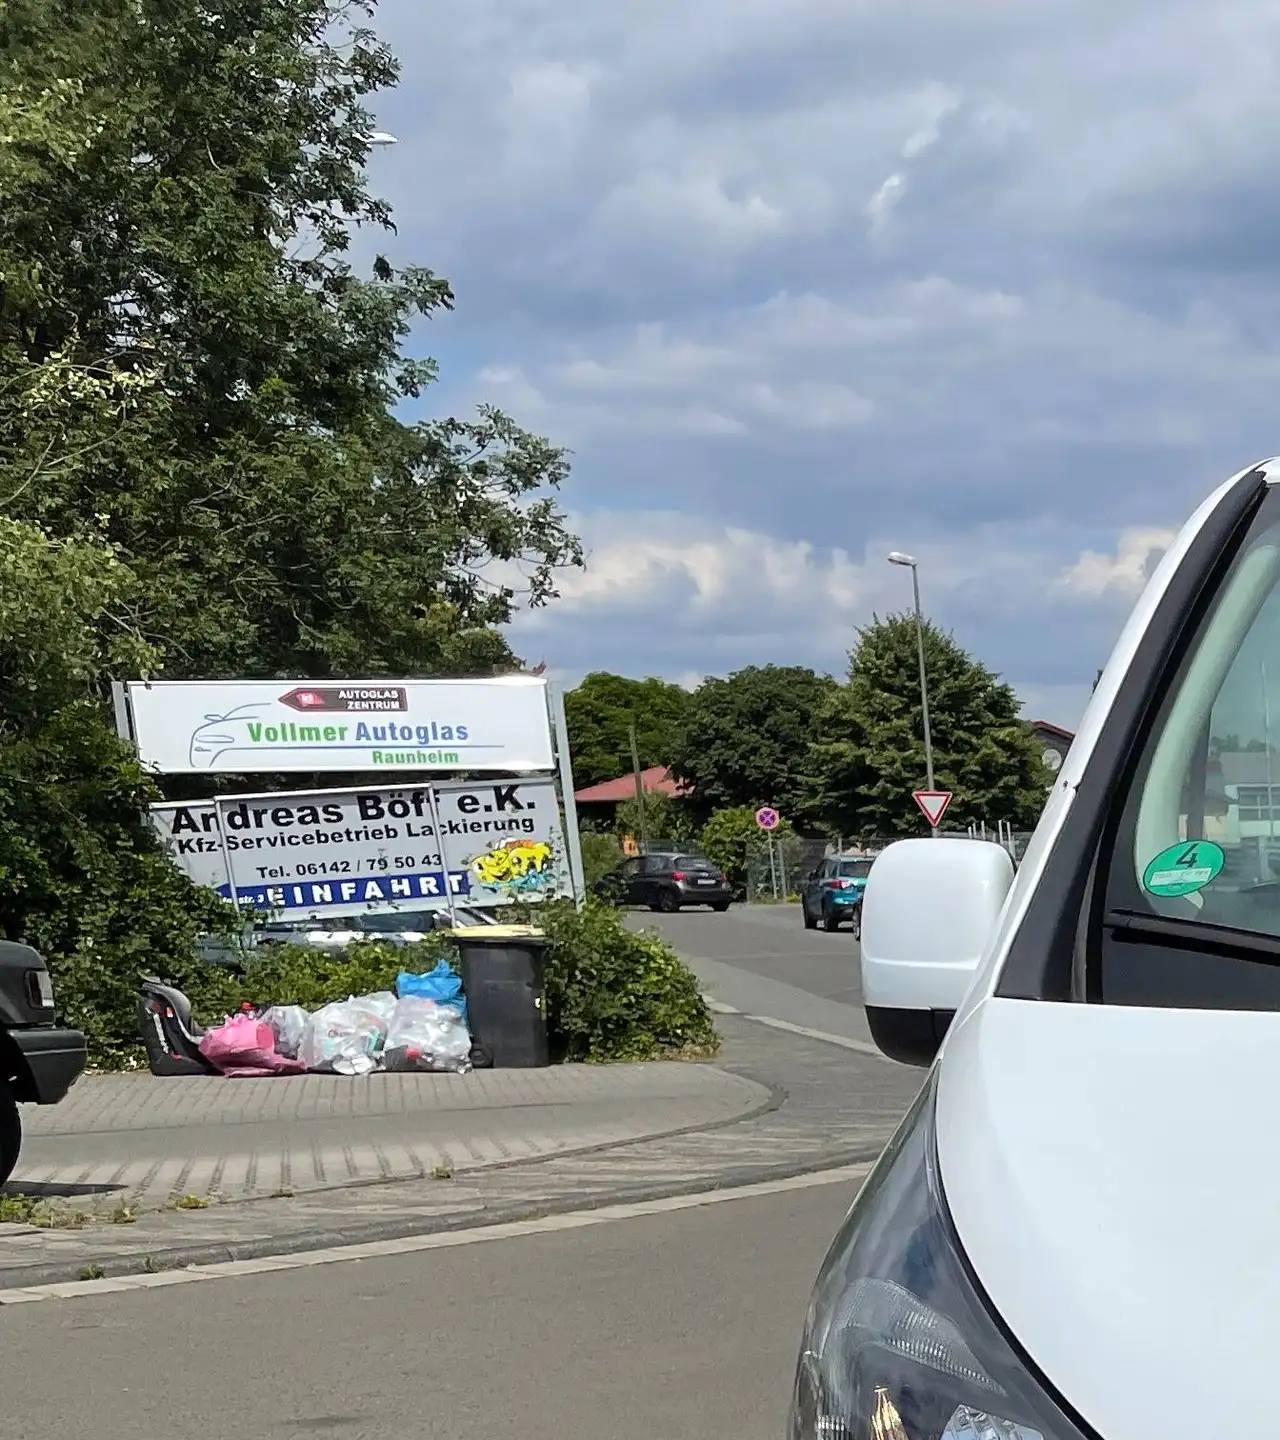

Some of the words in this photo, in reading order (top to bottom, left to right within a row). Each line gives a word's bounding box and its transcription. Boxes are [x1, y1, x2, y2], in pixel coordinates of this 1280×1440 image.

[338, 690, 399, 700] AUTOGLAS
[347, 701, 400, 710] ZENTRUM
[247, 722, 348, 743] Vollmer
[355, 722, 469, 745] Autoglas
[372, 750, 459, 764] Raunheim
[171, 802, 344, 835] Andreas
[457, 784, 536, 814] e.K.
[177, 824, 398, 854] Kfz-Servicebetrieb
[405, 817, 535, 839] Lackierung
[256, 866, 291, 879] Tel.
[296, 860, 351, 876] 06142
[365, 858, 388, 871] 79
[394, 856, 416, 868] 50
[421, 853, 443, 866] 43
[1176, 842, 1199, 868] 4
[266, 875, 464, 905] EINFAHRT
